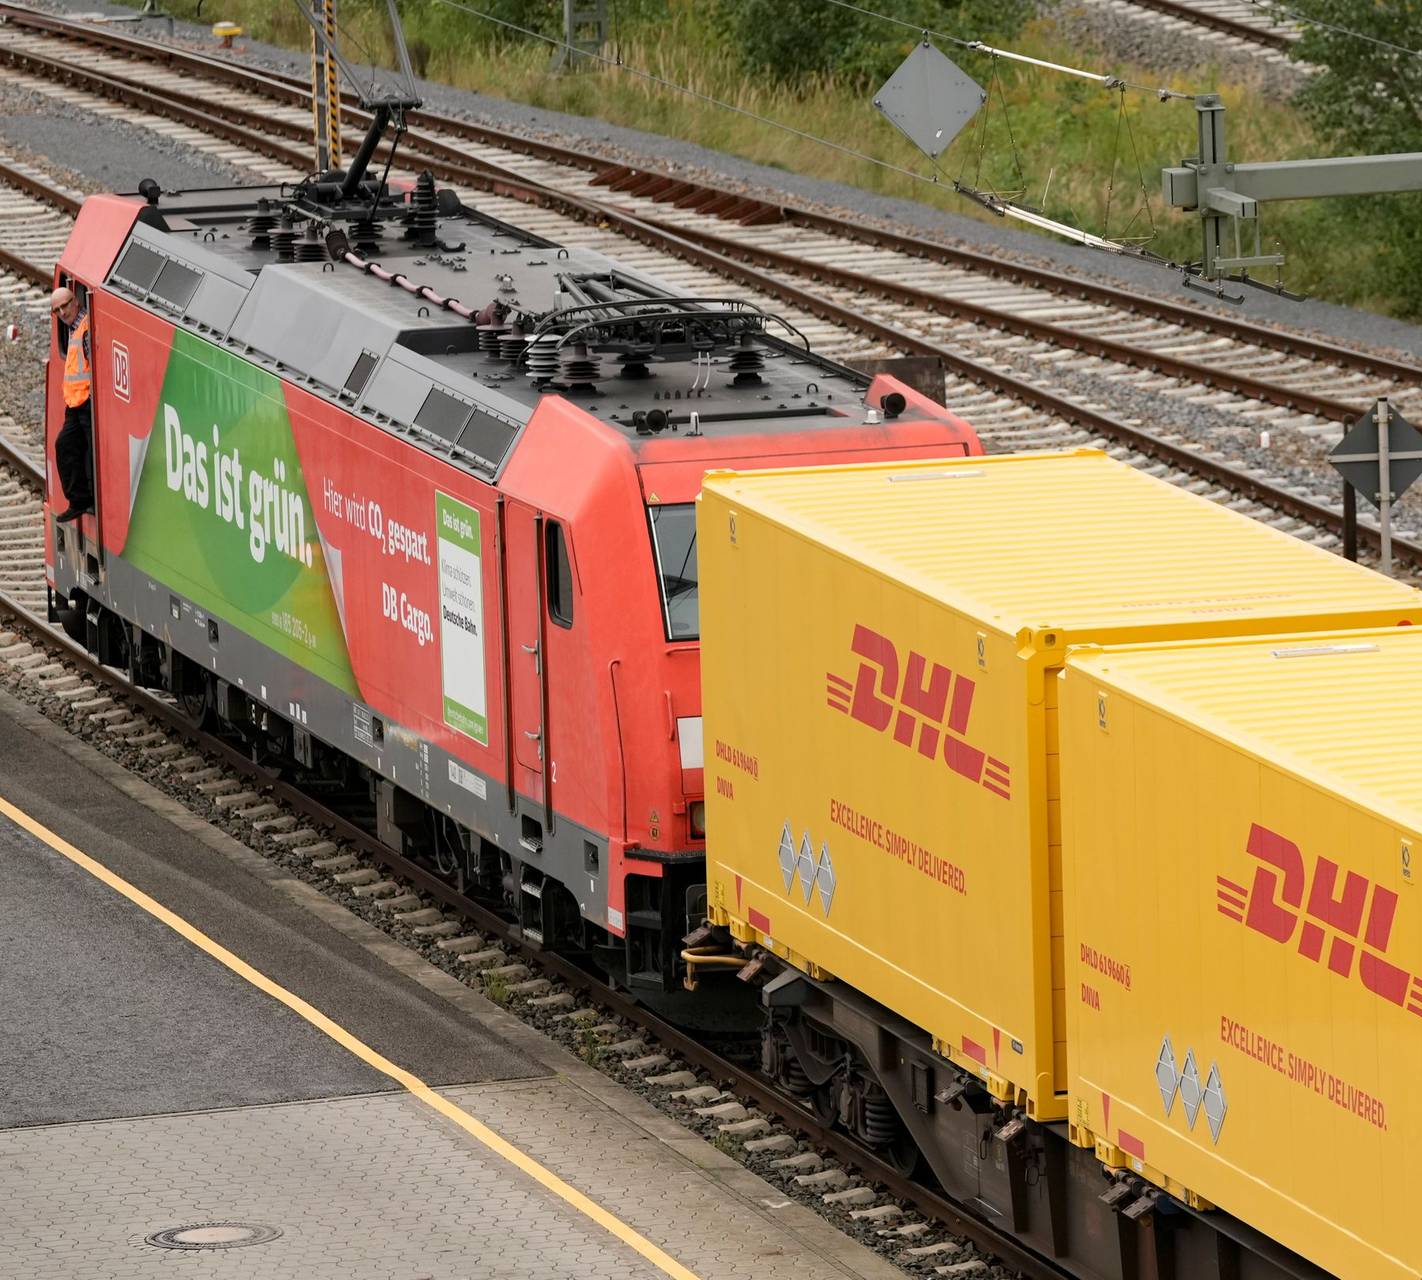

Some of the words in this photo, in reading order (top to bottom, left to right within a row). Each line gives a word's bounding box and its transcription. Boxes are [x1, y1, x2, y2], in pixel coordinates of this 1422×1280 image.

[164, 403, 209, 509] Das
[213, 424, 244, 529] ist
[249, 457, 312, 568] grün.
[323, 476, 343, 518] Hier
[345, 492, 366, 531] wird
[388, 519, 431, 565] gespart.
[382, 582, 398, 622] DB
[400, 593, 434, 646] Cargo.
[443, 605, 464, 630] Deutsche
[850, 623, 985, 784] DHL
[552, 761, 557, 784] 2
[716, 739, 732, 764] DHLD
[717, 776, 734, 800] DNVA
[830, 799, 885, 850] EXCELLENCE.
[885, 829, 918, 868] SIMPLY
[918, 850, 967, 896] DELIVERED.
[1245, 822, 1411, 1008] DHL
[1081, 943, 1098, 969] DHLD
[1099, 954, 1125, 985] 619660
[1081, 983, 1100, 1012] DNVA
[1221, 1016, 1286, 1075] EXCELLENCE.
[1288, 1053, 1326, 1095] SIMPLY
[1328, 1075, 1387, 1131] DELIVERED.
